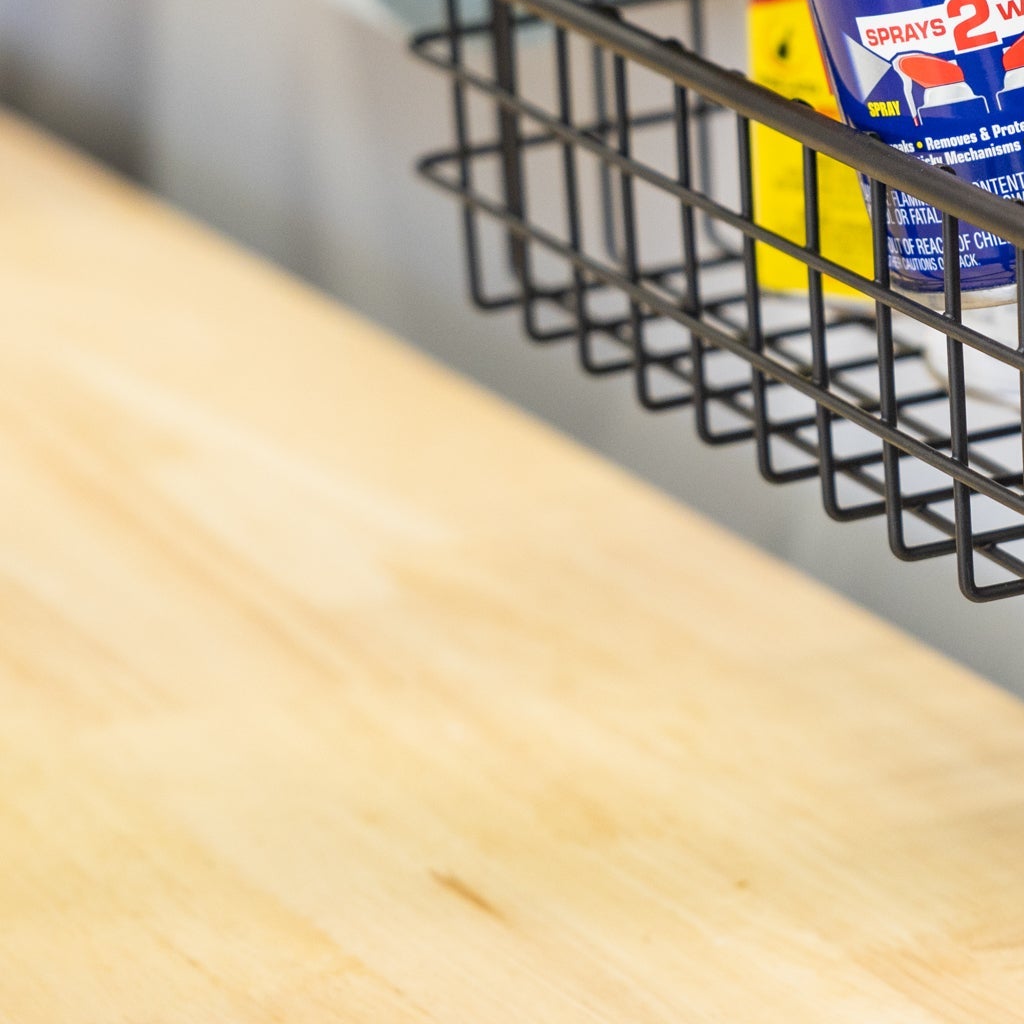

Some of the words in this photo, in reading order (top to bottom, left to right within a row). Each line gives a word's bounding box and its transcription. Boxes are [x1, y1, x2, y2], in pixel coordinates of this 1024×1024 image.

[865, 17, 948, 47] SPRAYS
[867, 101, 901, 118] SPRAY
[925, 133, 978, 151] Removes
[979, 126, 991, 142] &
[944, 139, 1022, 166] Mechanisms
[895, 208, 910, 226] OR
[909, 206, 943, 225] FATAL
[902, 237, 915, 255] OF
[915, 236, 944, 255] REAC
[959, 253, 982, 268] ACK.
